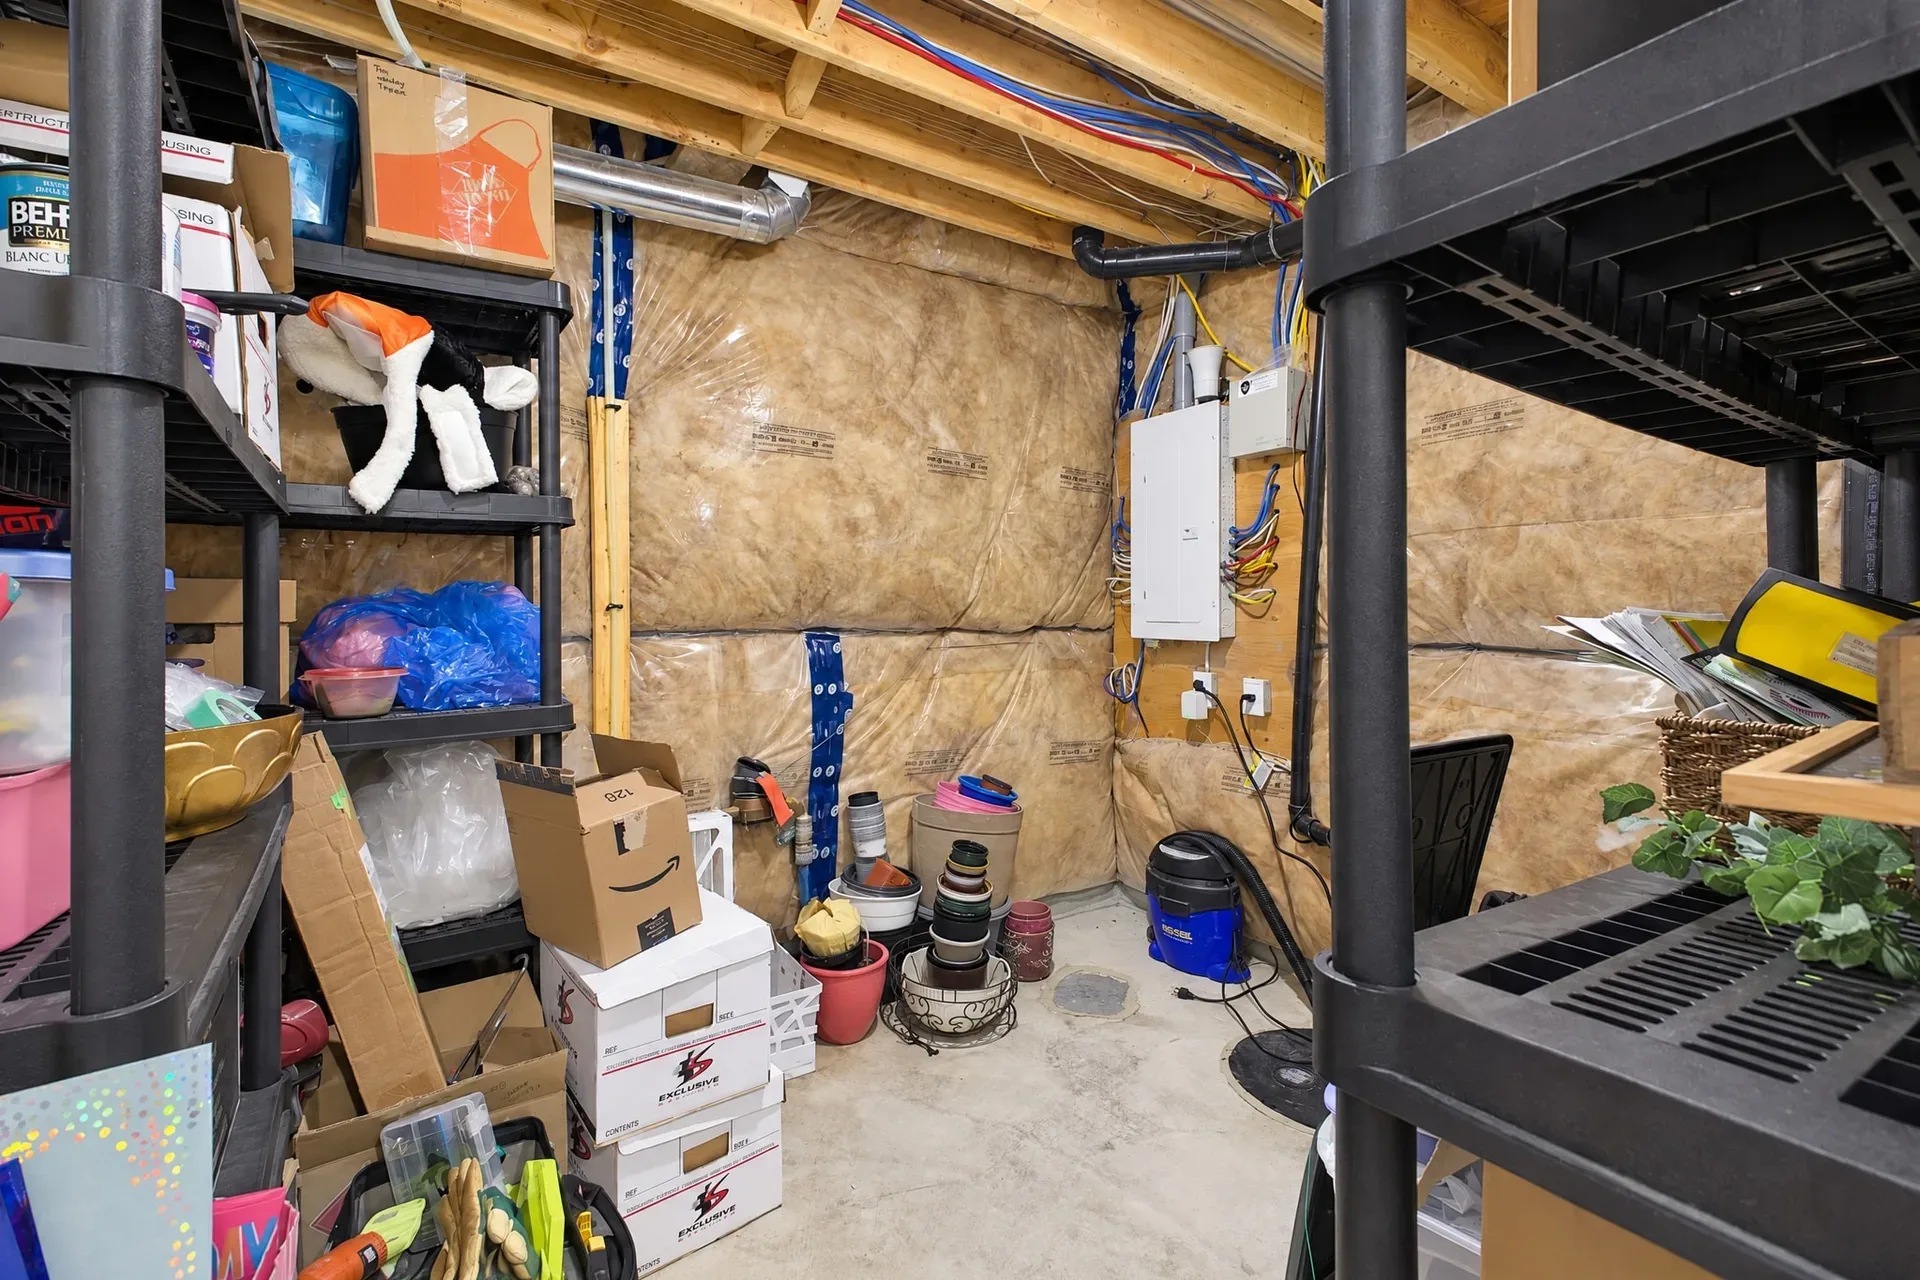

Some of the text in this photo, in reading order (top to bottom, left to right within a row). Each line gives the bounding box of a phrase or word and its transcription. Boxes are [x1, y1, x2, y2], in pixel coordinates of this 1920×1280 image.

[5, 250, 50, 263] BLANC
[604, 1045, 618, 1055] REF
[658, 1075, 720, 1103] EXCLUSIVE
[605, 1119, 640, 1138] CONTENTS
[625, 1187, 638, 1199] REF
[678, 1204, 736, 1238] EXCLUSIVE
